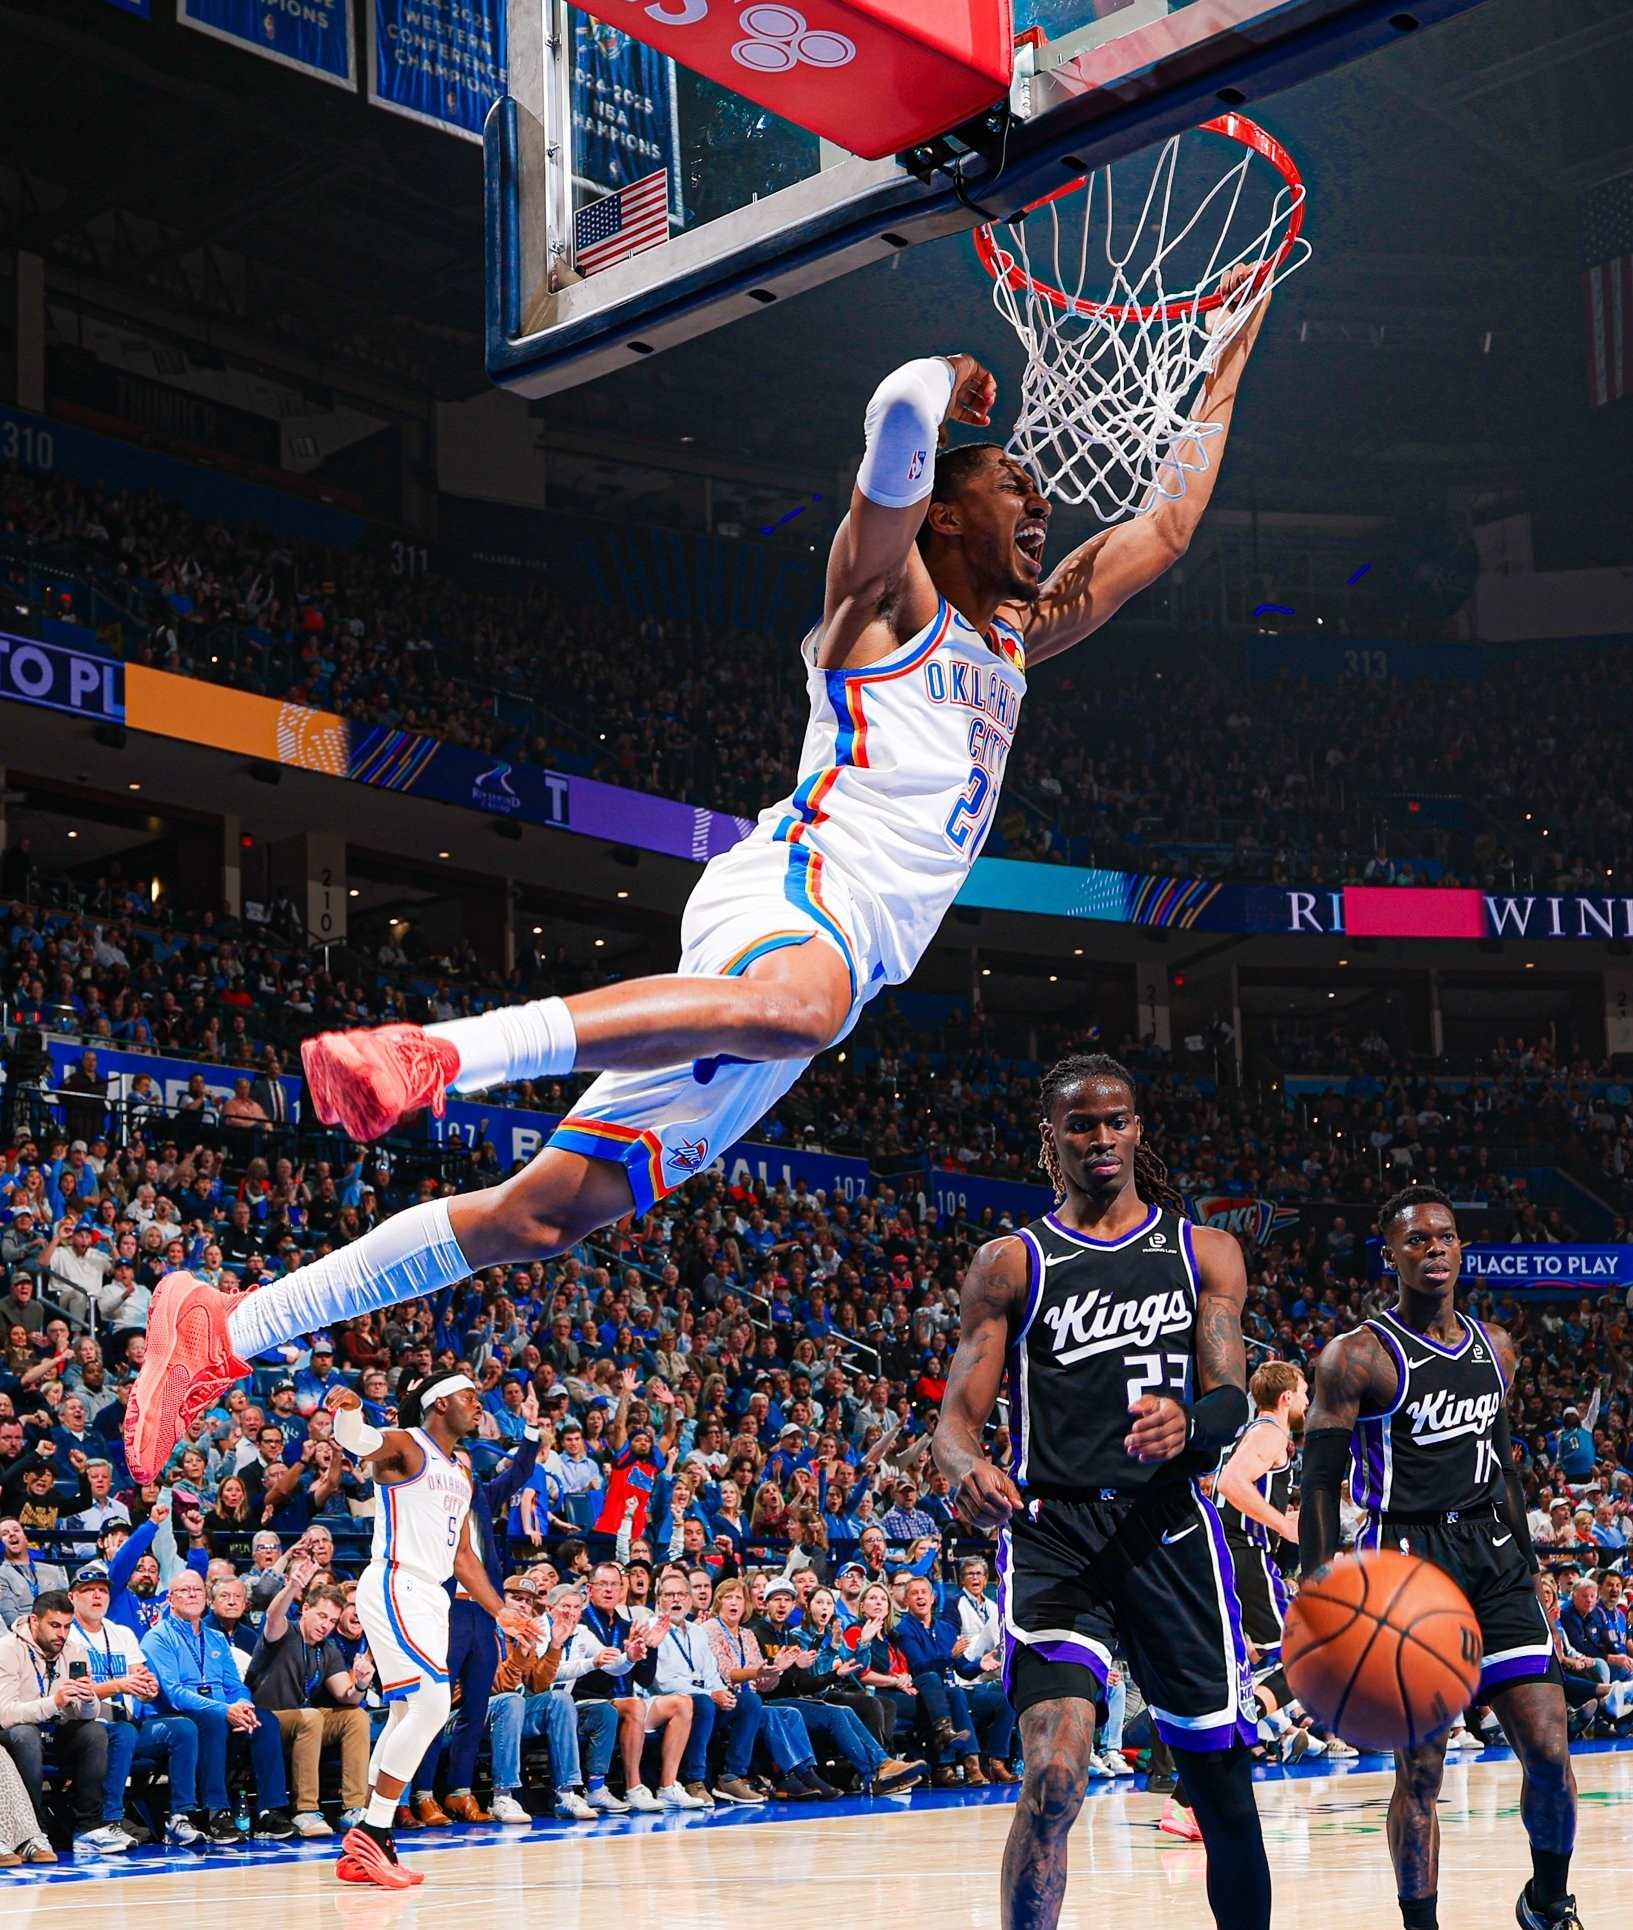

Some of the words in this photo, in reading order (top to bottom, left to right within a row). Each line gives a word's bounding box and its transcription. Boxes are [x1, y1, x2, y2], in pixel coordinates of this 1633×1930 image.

[387, 23, 507, 83] CONFERENCE
[404, 7, 492, 56] WESTERN
[573, 66, 654, 114] 024-2025
[594, 100, 629, 127] NBA
[572, 110, 661, 159] HAMPIONS
[3, 420, 53, 471] 310
[390, 540, 428, 578] 311
[1343, 649, 1388, 680] 313
[924, 660, 1020, 735] OKLAHO
[968, 717, 1011, 774] CITY
[321, 868, 332, 932] 210
[435, 1120, 475, 1149] 107
[1466, 1255, 1528, 1274] PLACE
[1533, 1256, 1562, 1274] TO
[1568, 1256, 1619, 1275] PLAY
[1043, 1288, 1193, 1365] Kings
[447, 1516, 457, 1546] 5
